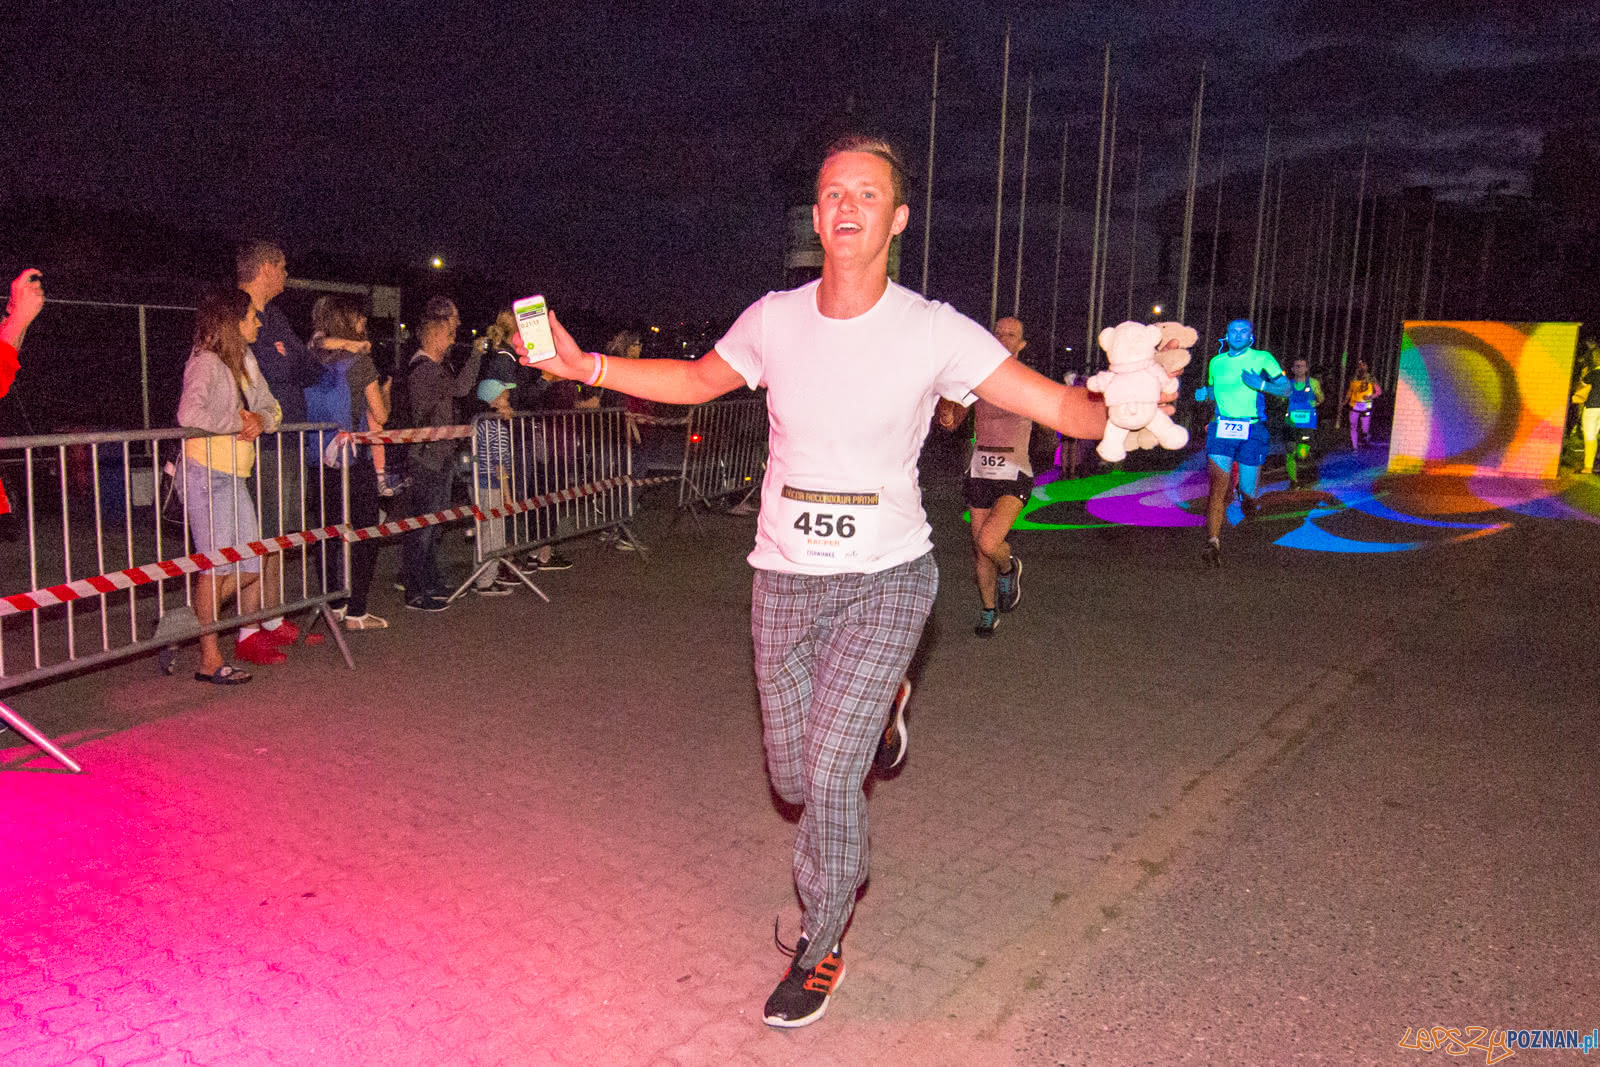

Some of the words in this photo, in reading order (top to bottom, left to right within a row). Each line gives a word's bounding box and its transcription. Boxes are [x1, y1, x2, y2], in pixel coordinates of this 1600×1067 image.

[1225, 422, 1243, 431] 773
[981, 455, 1006, 467] 362
[793, 511, 856, 539] 456
